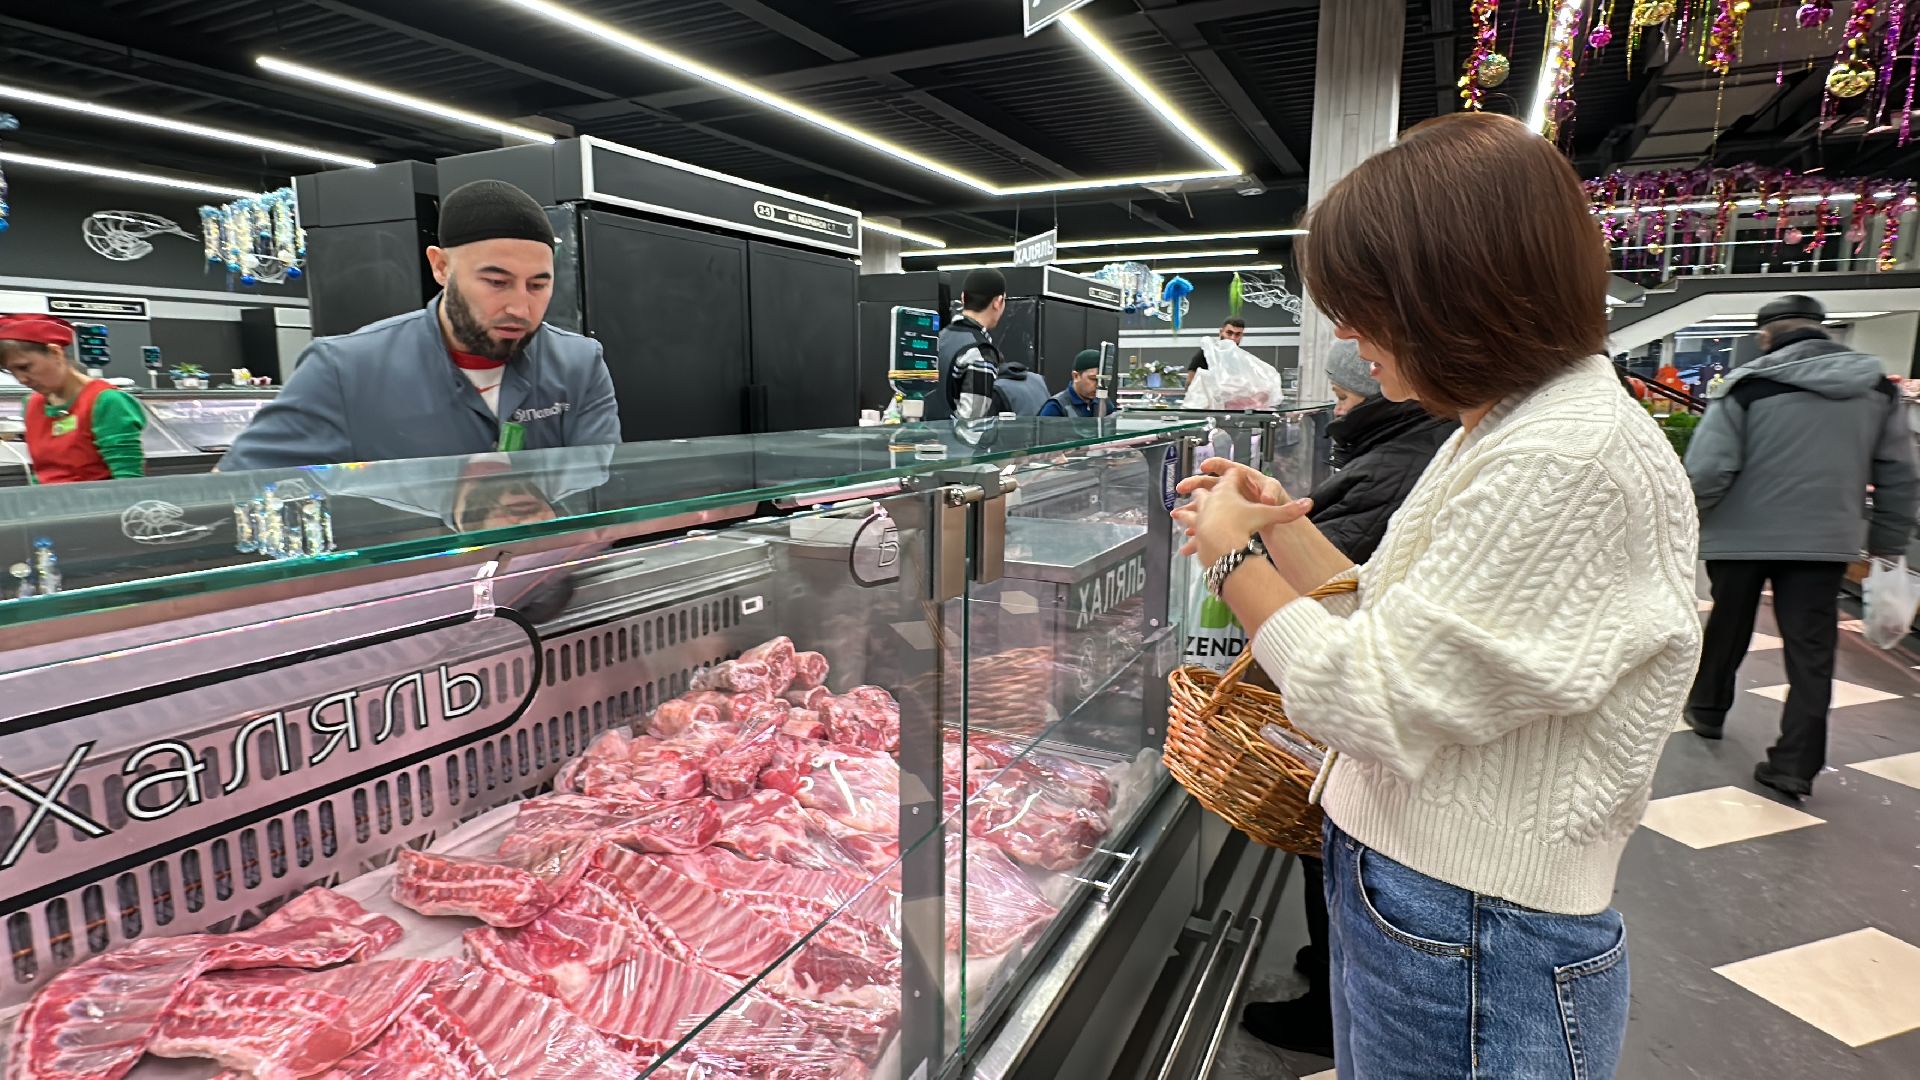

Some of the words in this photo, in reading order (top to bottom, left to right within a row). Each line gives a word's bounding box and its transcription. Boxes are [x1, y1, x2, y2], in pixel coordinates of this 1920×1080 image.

[1015, 239, 1054, 264] ХАЛЯЛЬ
[1076, 555, 1146, 630] ХАЛЯЛЬ
[1183, 636, 1251, 657] ZEND
